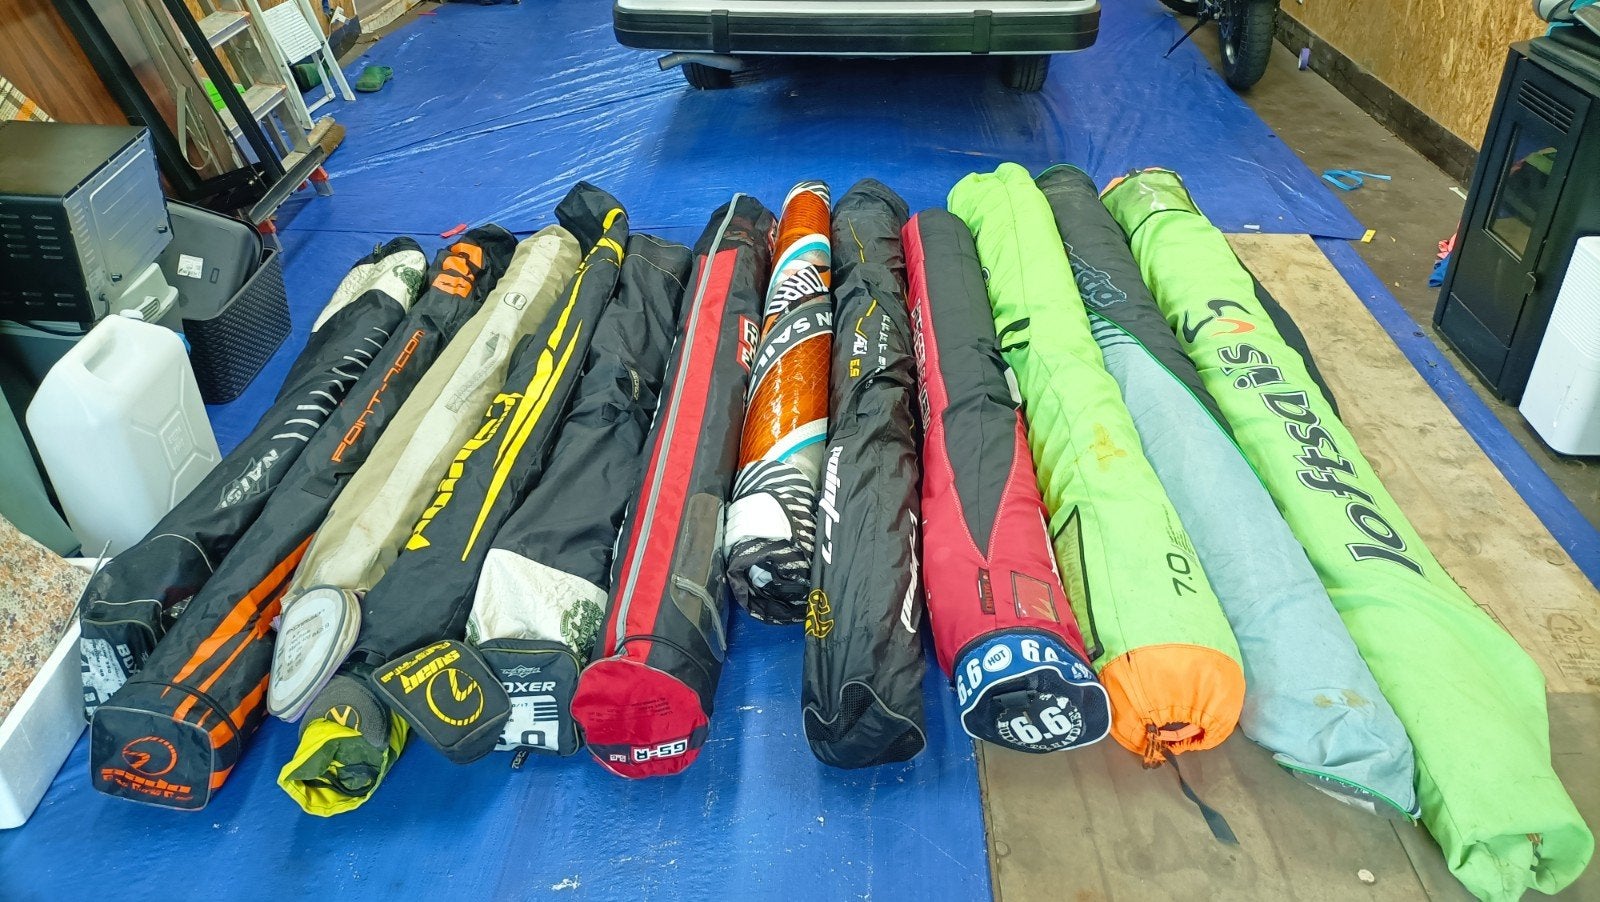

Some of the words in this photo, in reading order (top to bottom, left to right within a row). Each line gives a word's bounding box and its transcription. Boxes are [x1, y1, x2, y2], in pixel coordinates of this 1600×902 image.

[1166, 552, 1197, 597] 7.0
[957, 658, 984, 706] 6.6
[986, 648, 1008, 668] HOT
[1010, 706, 1072, 744] 6.6
[633, 738, 688, 762] GS-R
